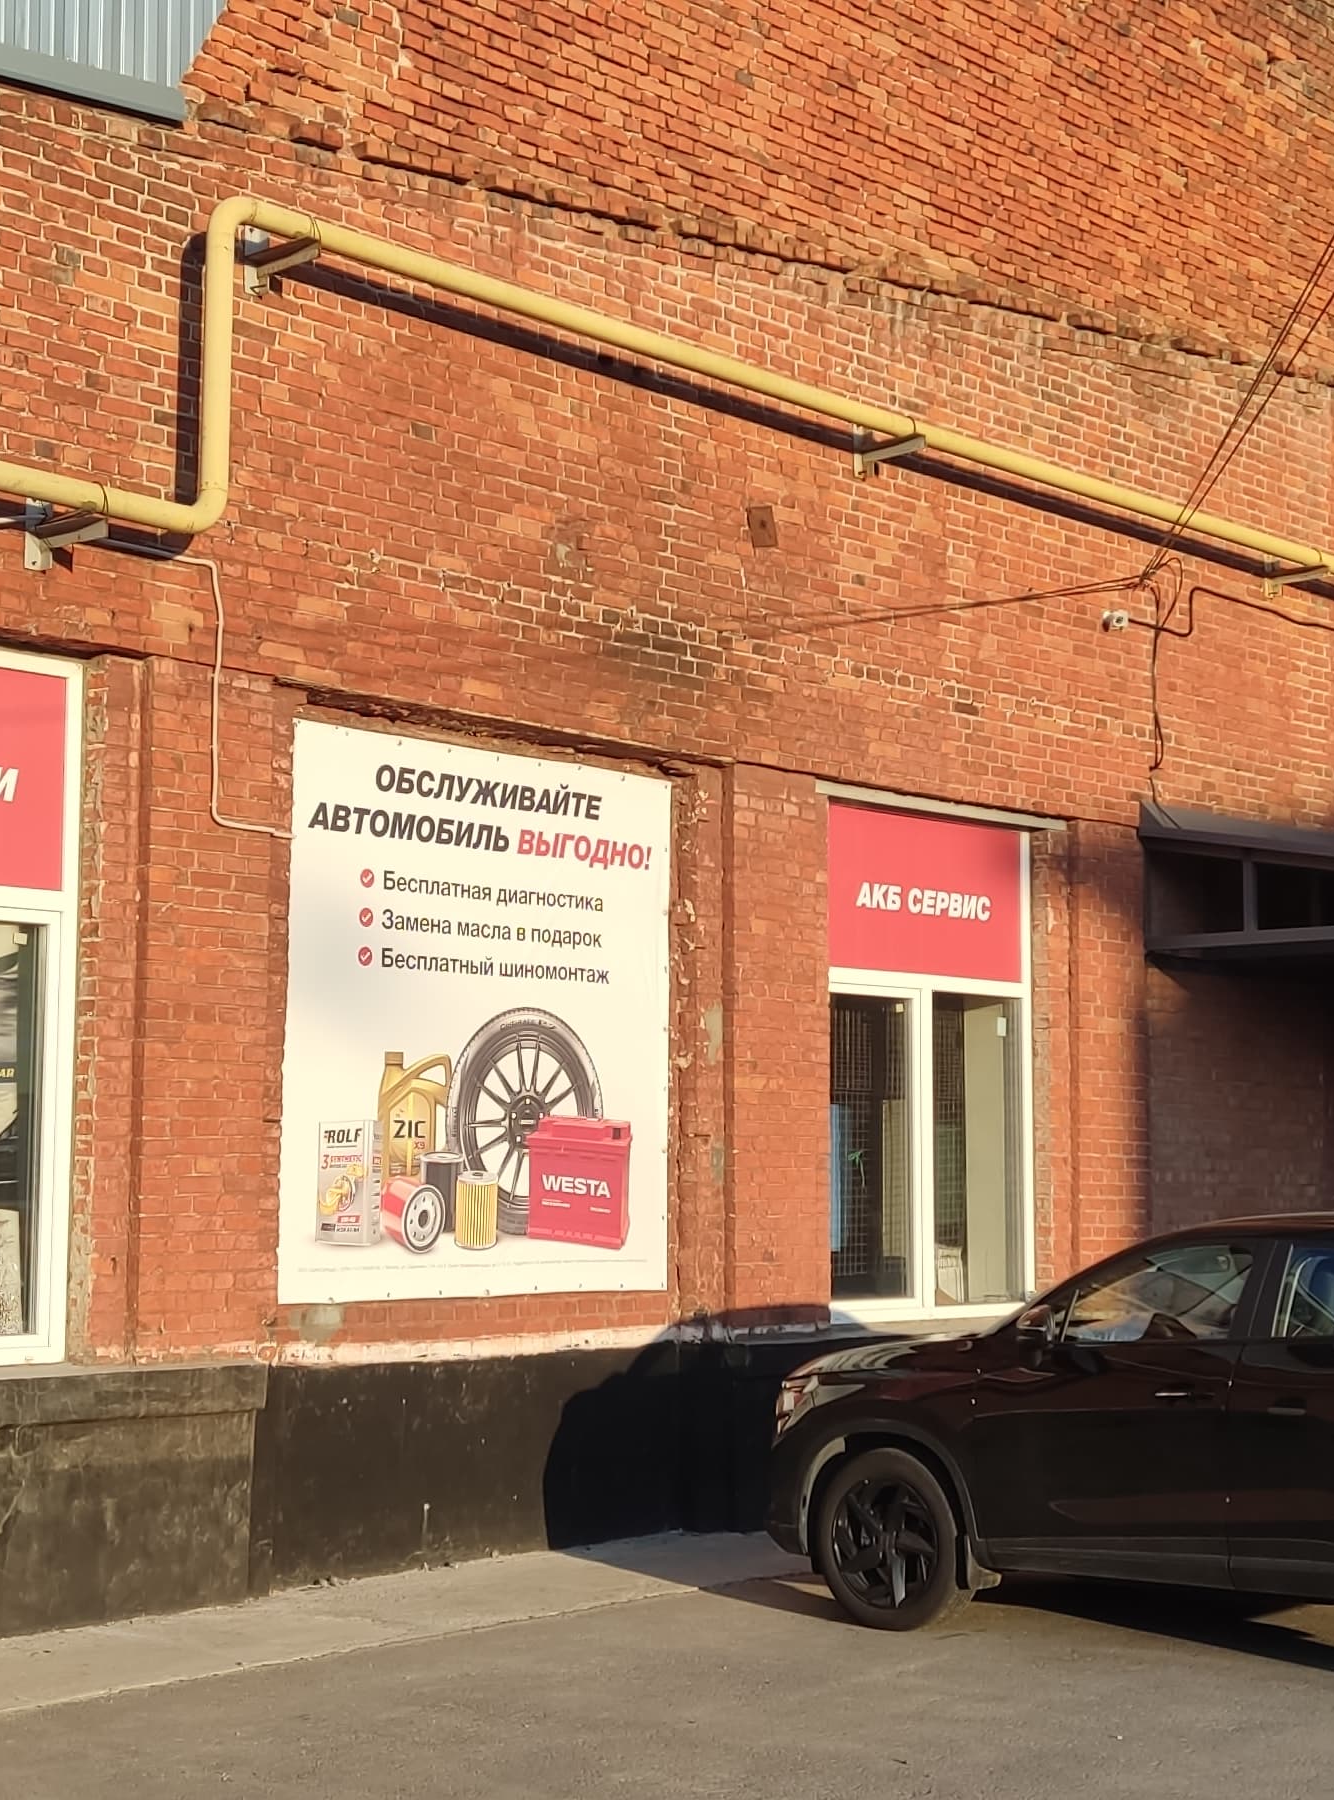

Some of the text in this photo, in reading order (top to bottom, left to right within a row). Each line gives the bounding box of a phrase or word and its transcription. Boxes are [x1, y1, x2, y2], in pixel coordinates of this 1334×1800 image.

[375, 764, 602, 820] ОБСЛУЖИВАЙТЕ
[308, 802, 652, 870] АВТОМОБИЛЬ ВЫГОДНО!
[383, 871, 604, 912] Бесплатная диагностика
[856, 882, 992, 921] АКБ СЕРВИС
[382, 909, 602, 949] Замена масла в подарок
[381, 948, 610, 984] Бесплатный шиномонтаж
[327, 1128, 362, 1143] ROLF
[393, 1120, 426, 1138] ZIC
[542, 1174, 611, 1198] WESTA
